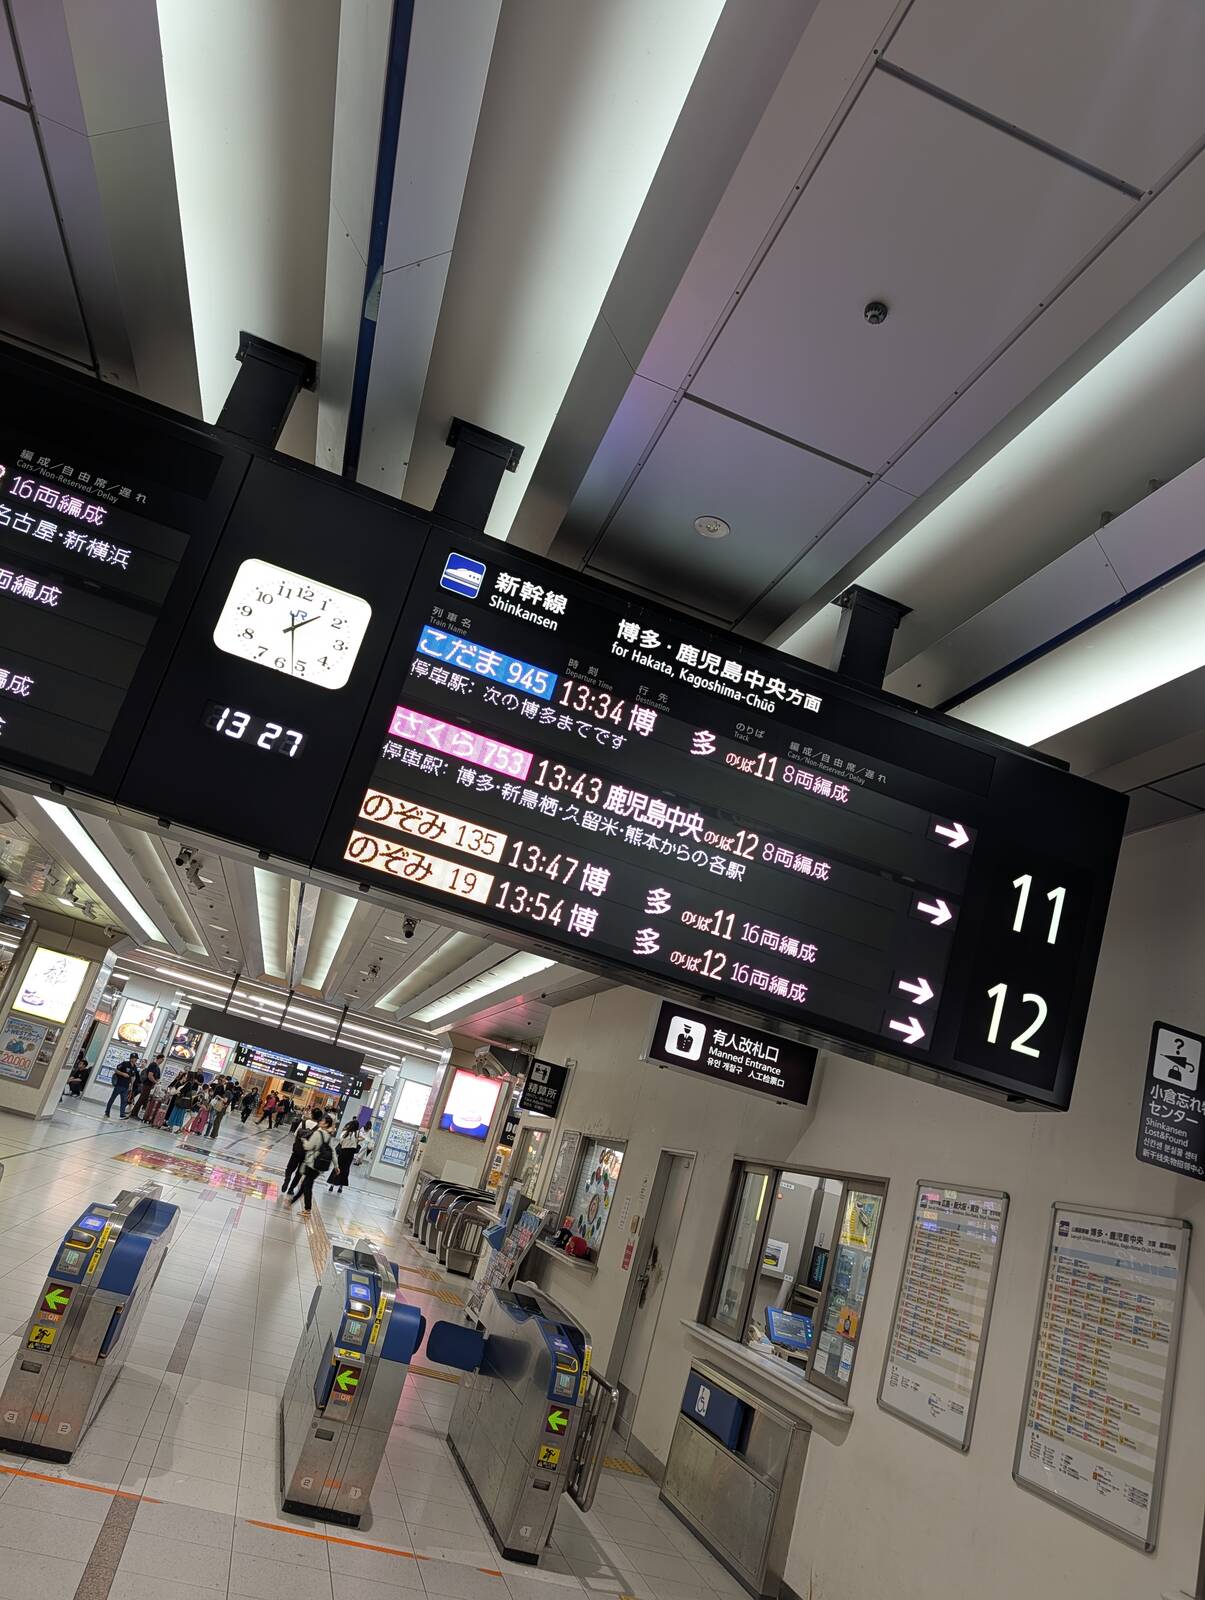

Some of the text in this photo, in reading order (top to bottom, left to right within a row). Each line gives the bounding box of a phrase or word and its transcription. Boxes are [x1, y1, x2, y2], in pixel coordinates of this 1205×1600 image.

[9, 476, 108, 526] 16両編成
[256, 591, 274, 605] 10
[277, 585, 292, 600] 11
[296, 587, 315, 602] 12
[494, 572, 568, 615] 新幹線
[240, 605, 253, 617] 9
[489, 594, 559, 632] Shinkansen
[242, 627, 255, 640] 8
[331, 617, 343, 630] 2
[429, 614, 468, 637] Train Name
[257, 645, 269, 657] 7
[332, 639, 345, 651] 3
[274, 657, 286, 669] 6
[294, 660, 307, 672] 5
[317, 656, 329, 667] 4
[617, 618, 823, 714] 博多・鹿児島中央方面
[564, 666, 614, 692] Departure Time
[611, 641, 777, 714] for Hakata, Kagoshima-Chūō
[635, 693, 671, 714] Destination
[419, 629, 503, 677] こだま
[508, 661, 550, 695] 945
[558, 679, 627, 726] 13:34
[782, 764, 851, 804] 8両編成
[482, 685, 628, 752] 次の博多までです
[215, 706, 304, 758] 13 27
[733, 730, 750, 744] Track
[735, 721, 766, 740] のりば
[392, 710, 476, 757] さくら
[483, 742, 527, 777] 753
[533, 759, 604, 805] 13:43
[602, 784, 705, 845] 鹿児島中央
[761, 842, 832, 881] 8両編成
[362, 792, 449, 841] のぞみ
[454, 824, 497, 857] 135
[507, 840, 578, 886] 13:47
[741, 921, 818, 964] 16両編成
[348, 832, 434, 883] のぞみ
[447, 867, 478, 895] 19
[494, 880, 565, 927] 13:54
[729, 961, 808, 1003] 16両編成
[1011, 873, 1068, 946] 11
[986, 981, 1050, 1059] 12
[712, 1028, 780, 1063] 有人改札口
[708, 1046, 781, 1076] Manned Entrance
[1149, 1100, 1199, 1124] センター
[1144, 1126, 1189, 1148] Lost&Found
[1145, 1117, 1188, 1138] Shinkansen
